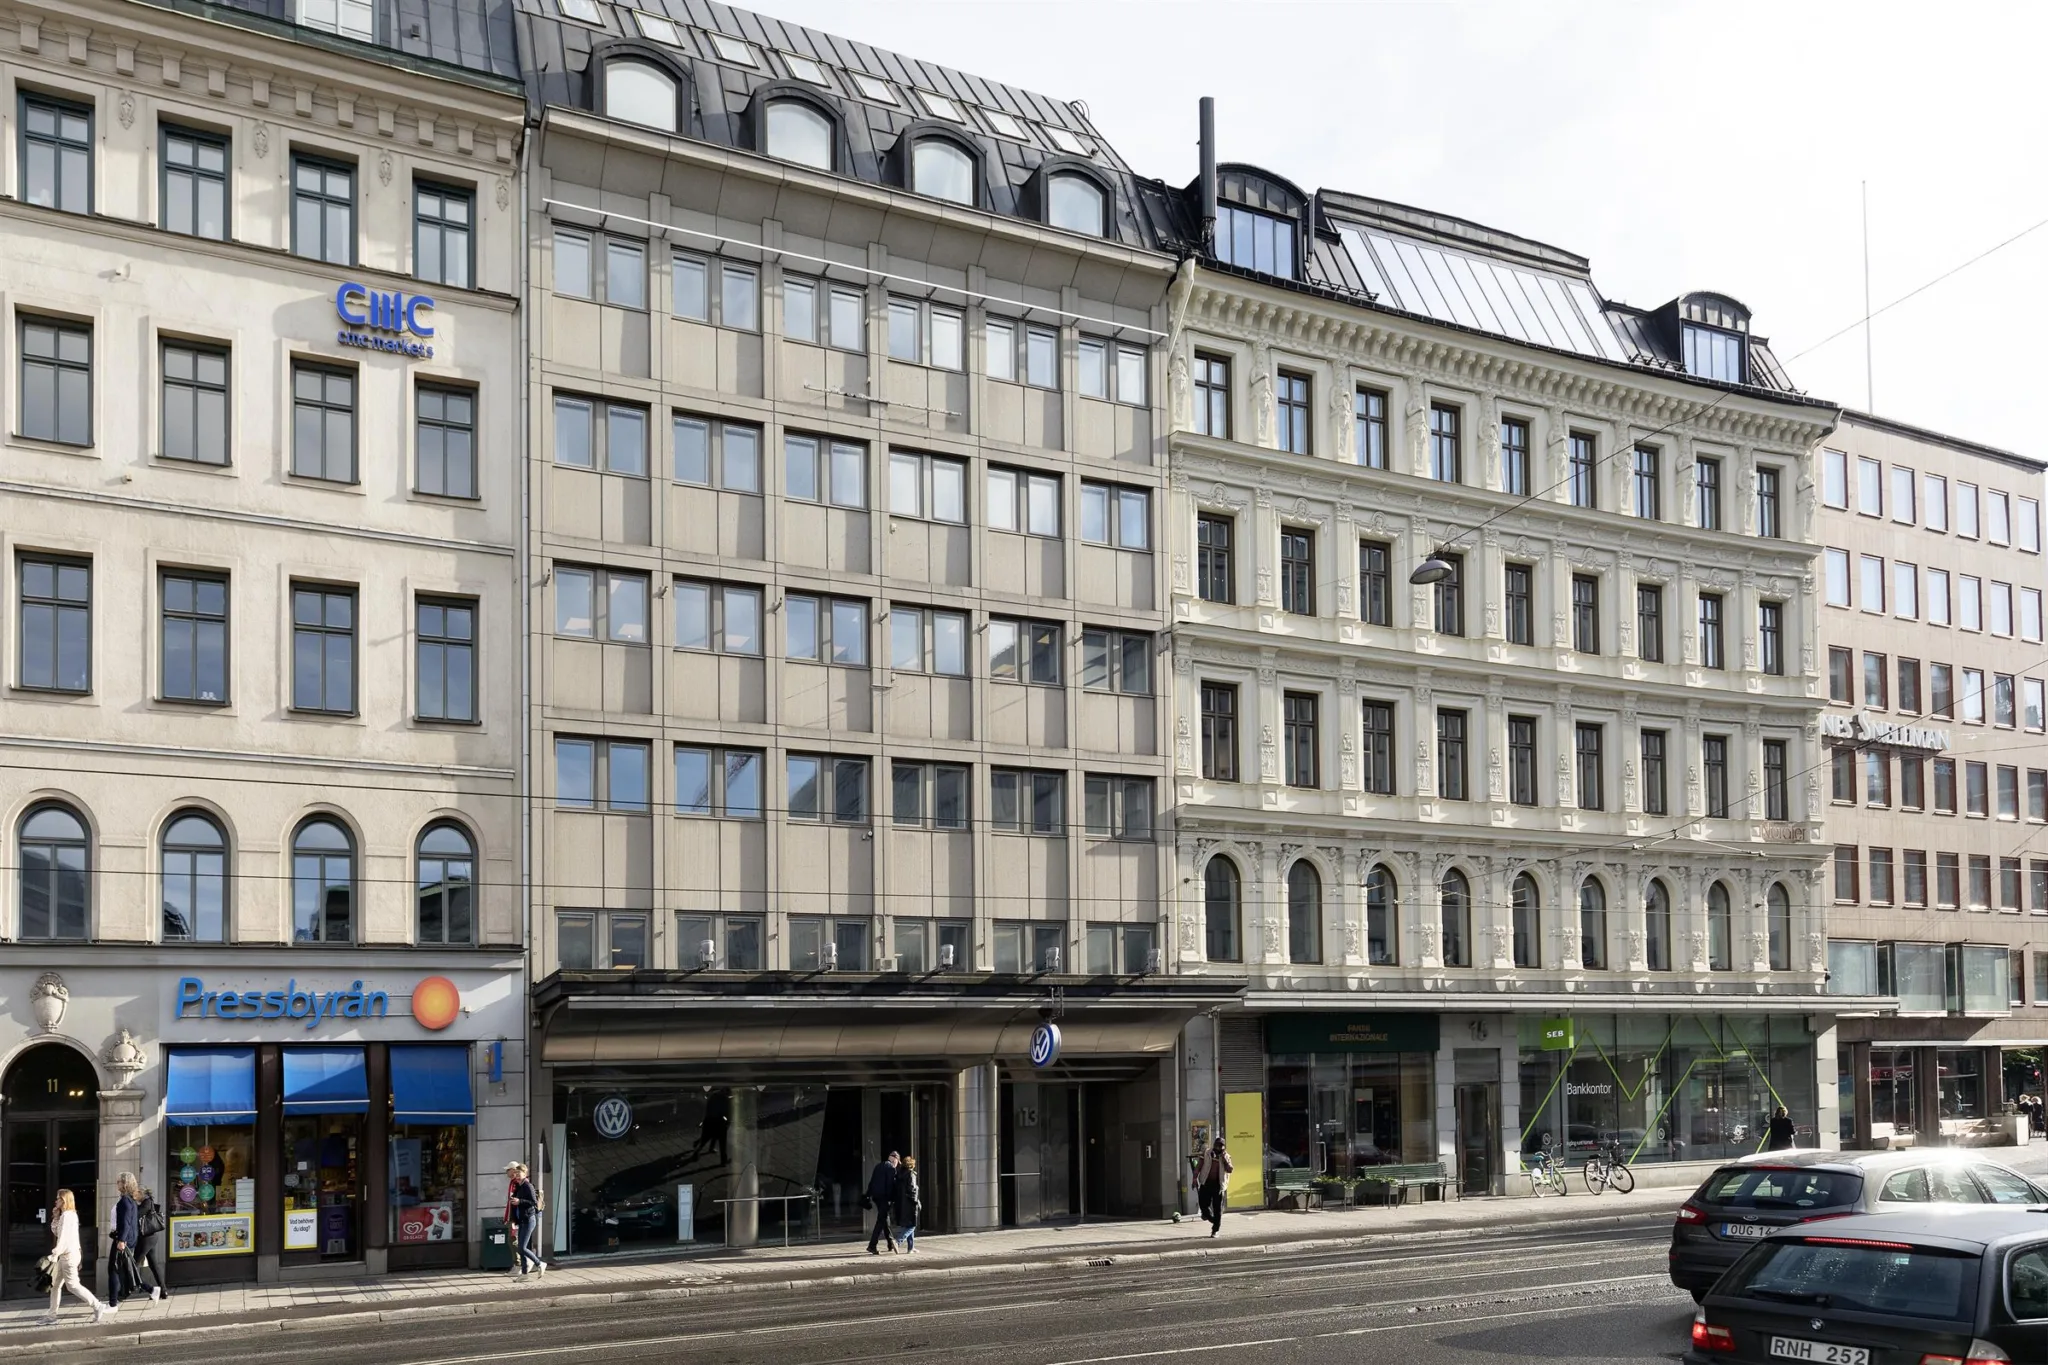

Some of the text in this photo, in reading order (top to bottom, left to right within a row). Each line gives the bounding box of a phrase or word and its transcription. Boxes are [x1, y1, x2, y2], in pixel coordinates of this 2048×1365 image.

[338, 331, 434, 359] cmc markets
[1820, 713, 1853, 738] NES
[175, 977, 388, 1029] Pressbyrån
[1546, 1030, 1564, 1038] SEB
[47, 1078, 58, 1093] 11
[1566, 1082, 1612, 1095] Bankkontor
[1730, 1224, 1780, 1237] OUG 14
[1774, 1338, 1867, 1365] RNH 252
